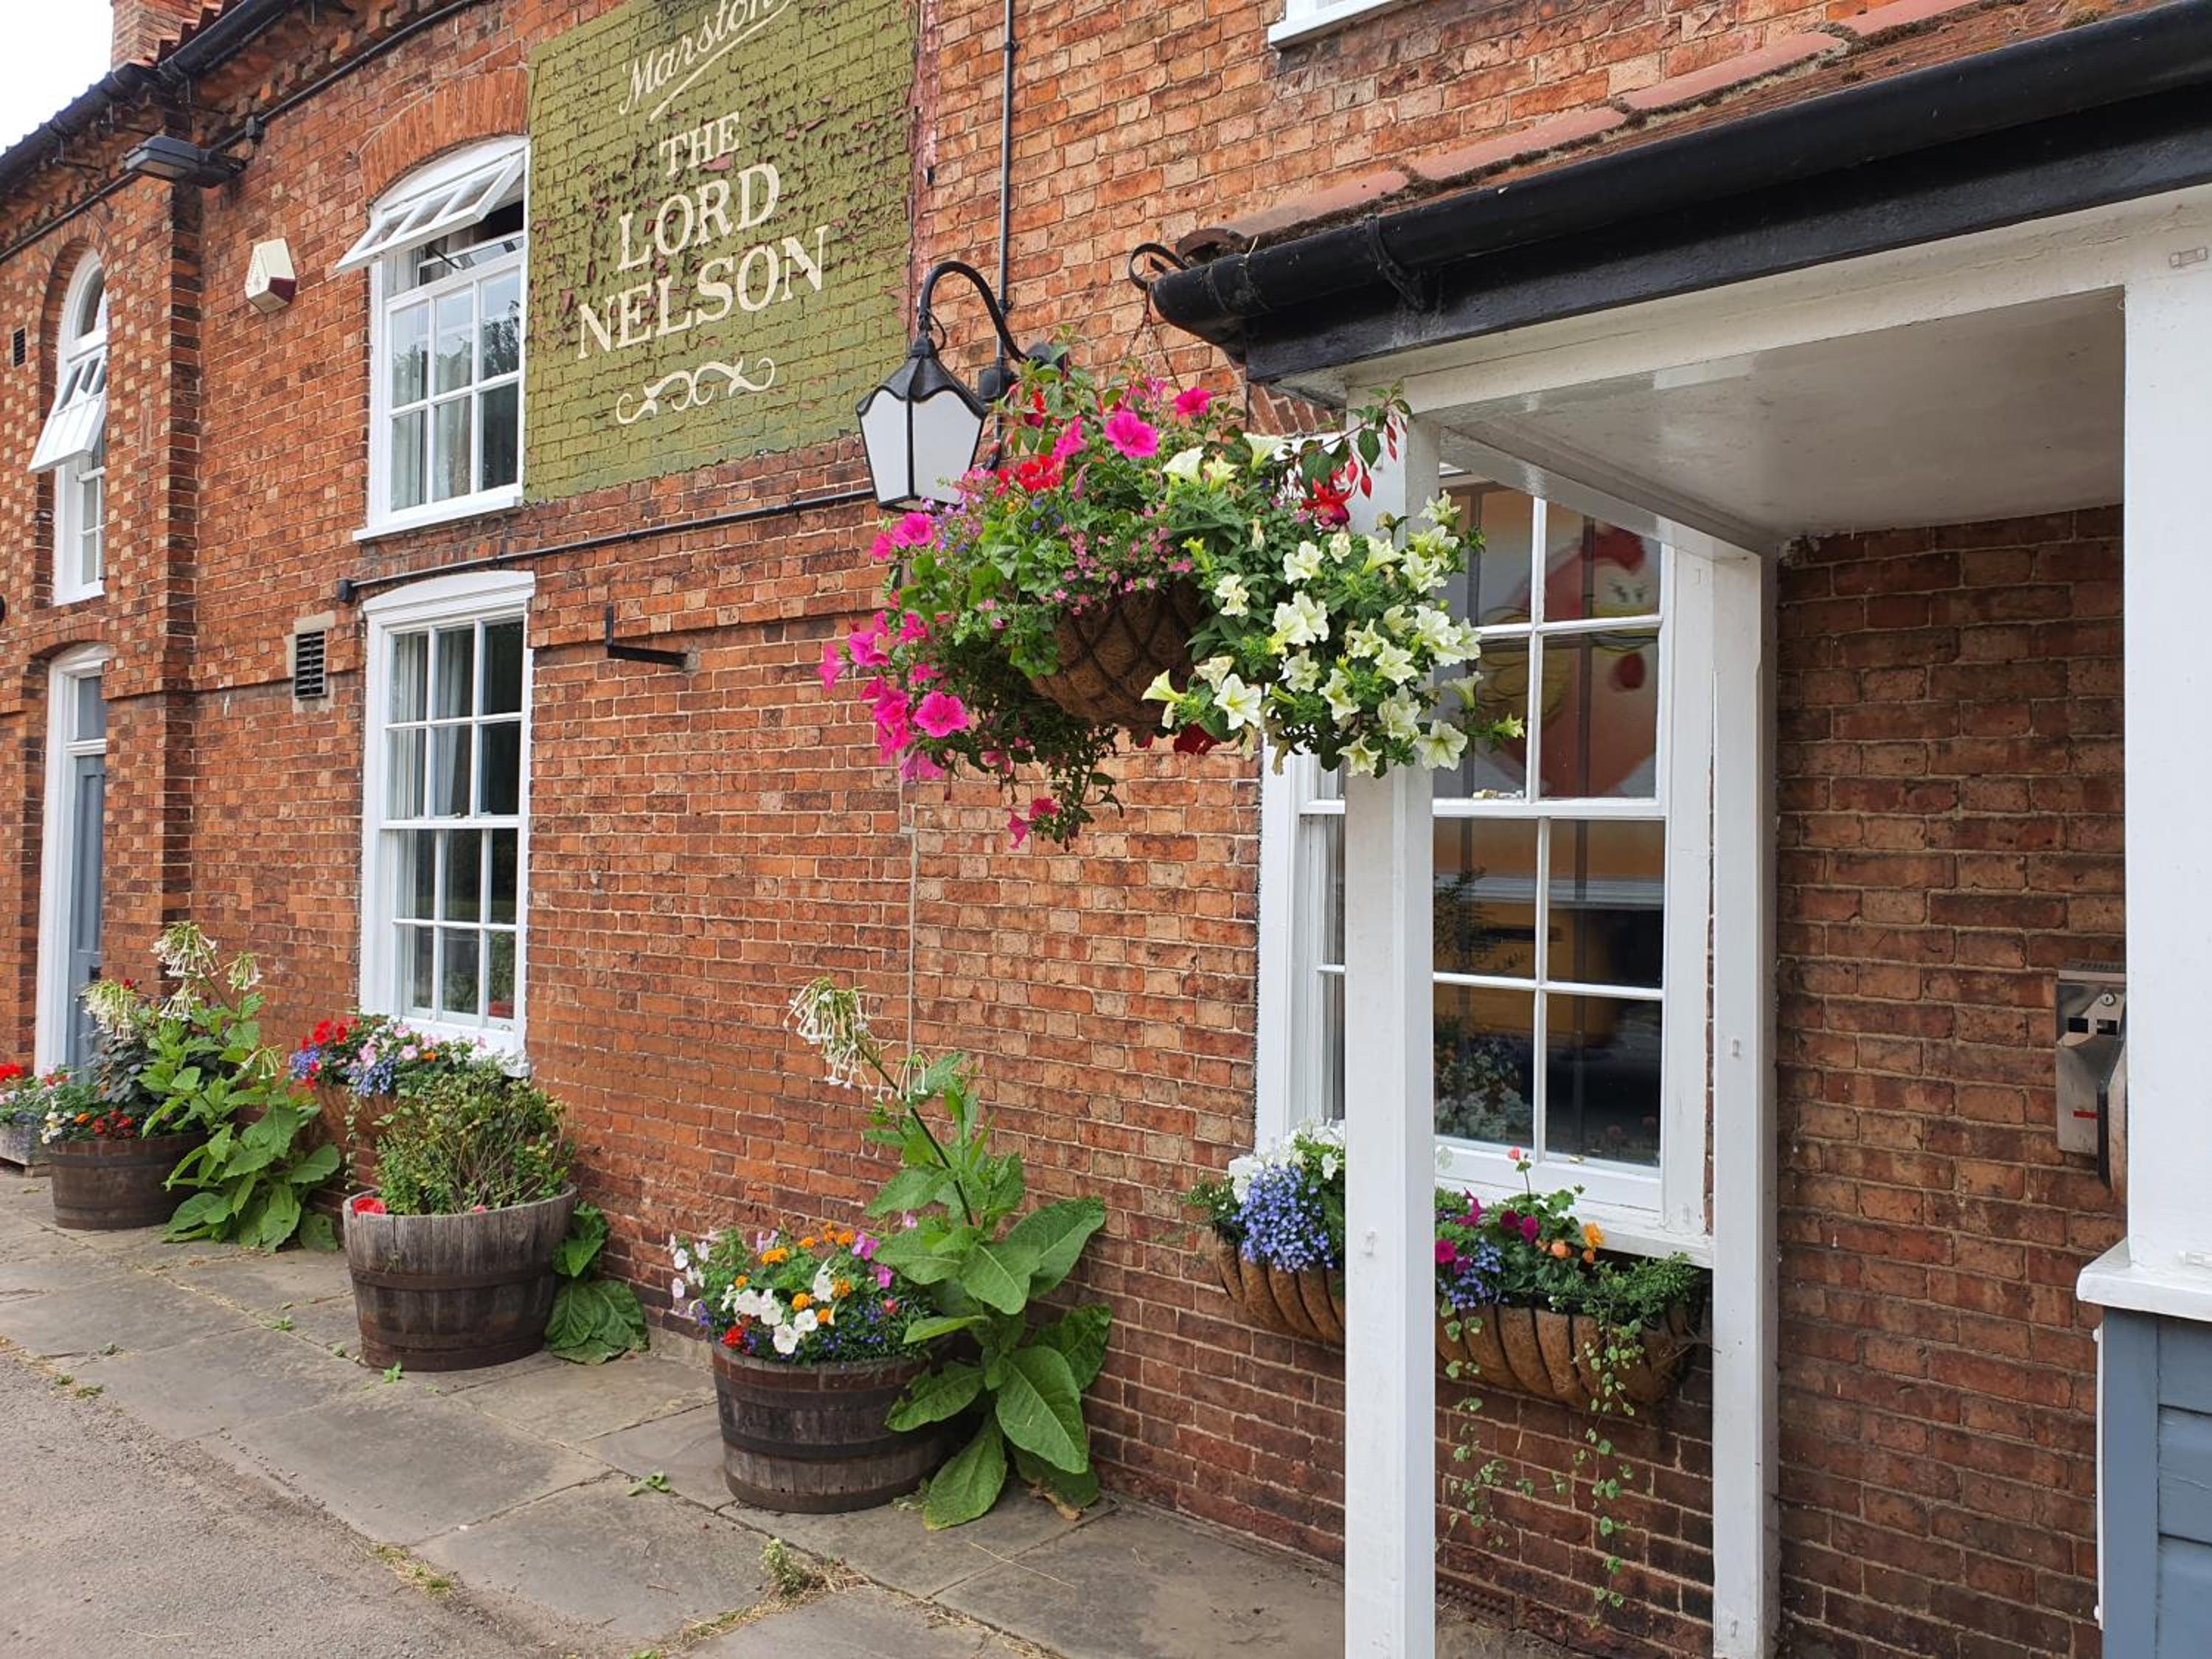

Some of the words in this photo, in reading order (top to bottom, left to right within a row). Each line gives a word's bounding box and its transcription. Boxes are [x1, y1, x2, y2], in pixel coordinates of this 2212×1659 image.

[659, 112, 740, 177] THE
[616, 163, 780, 271] LORD
[577, 226, 828, 359] NELSON
